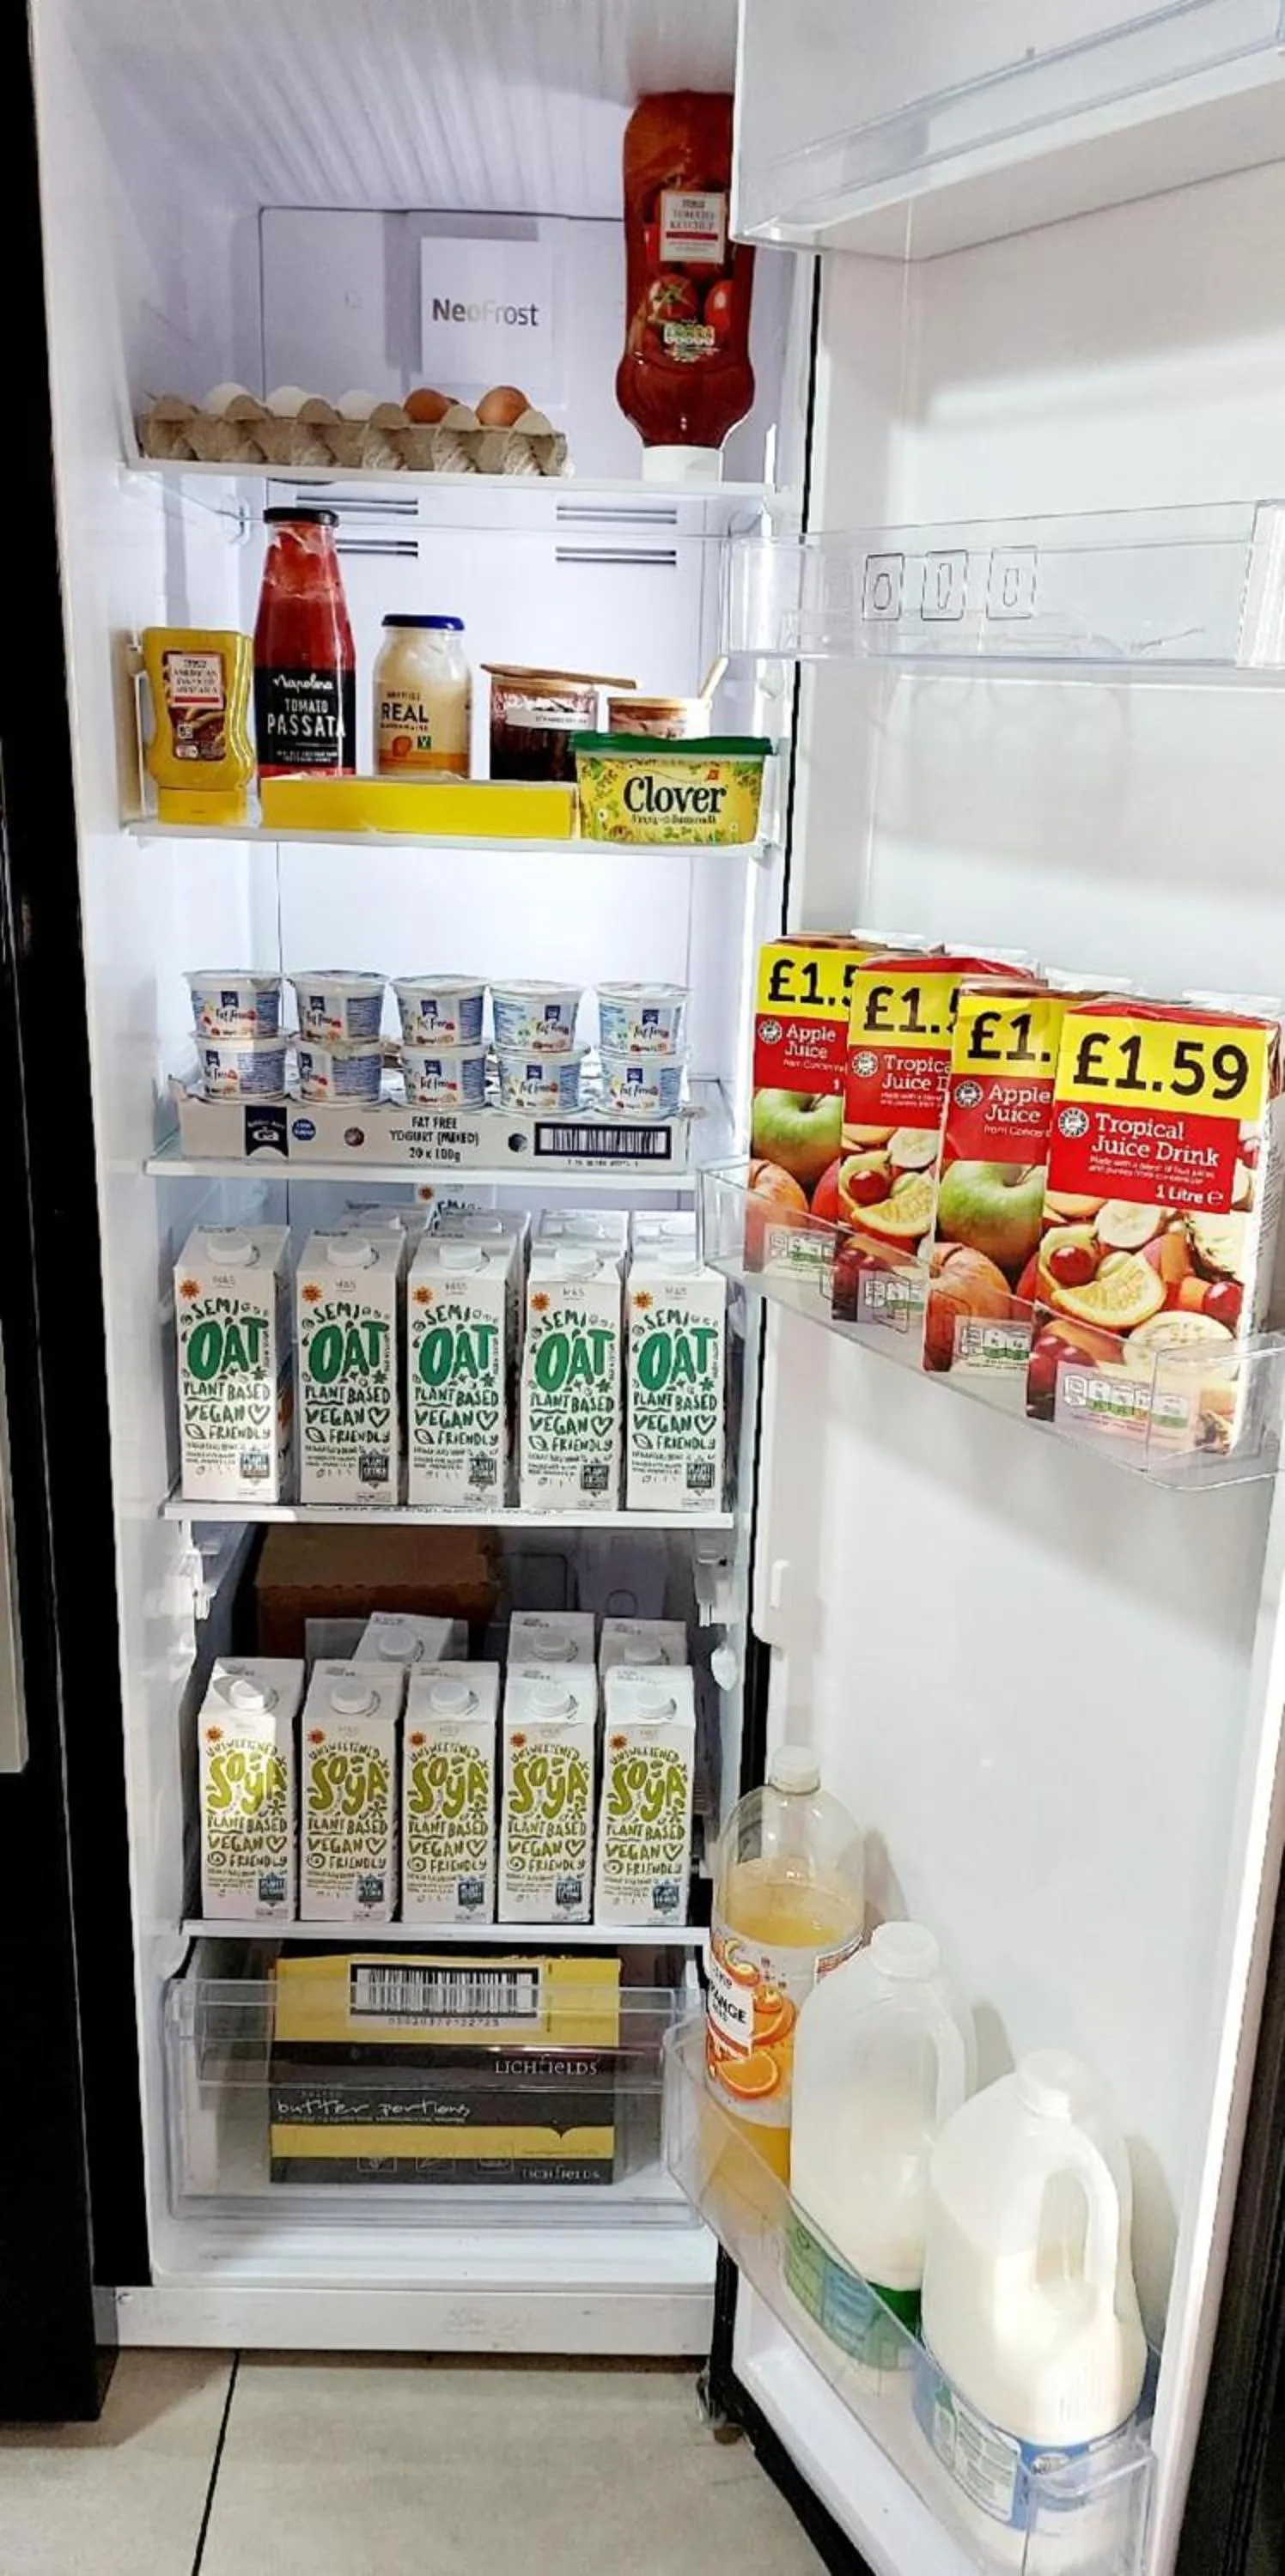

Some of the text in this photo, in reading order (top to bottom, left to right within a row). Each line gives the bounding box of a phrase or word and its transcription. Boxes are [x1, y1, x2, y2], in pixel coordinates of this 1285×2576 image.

[432, 298, 539, 326] NeoFrost
[284, 698, 329, 714] TOMATO
[381, 702, 429, 723] REAL
[267, 714, 346, 738] PASSATA
[624, 775, 728, 813] Clover
[785, 1024, 837, 1042] Apple
[967, 1011, 1051, 1062] £1.
[783, 1042, 828, 1059] Juice
[1073, 1032, 1249, 1100] £1.59
[881, 1072, 932, 1091] Juice
[989, 1084, 1051, 1107] Apple
[411, 1115, 458, 1129] FAT FREE
[984, 1104, 1042, 1123] Juice
[1094, 1112, 1184, 1140] Tropical
[389, 1130, 434, 1143] YOGURT
[409, 1147, 423, 1158] 20
[435, 1147, 461, 1163] 100g
[1091, 1134, 1220, 1168] Juice Drink
[1155, 1184, 1203, 1204] 1 Litre
[191, 1297, 240, 1320] SEMI
[313, 1302, 360, 1323] SEMI
[424, 1304, 471, 1325] SEMI
[541, 1309, 587, 1331] SEMI
[643, 1309, 689, 1330] SEMI
[187, 1316, 269, 1381] OAT
[308, 1320, 390, 1384] OAT
[418, 1323, 499, 1387] OAT
[535, 1328, 616, 1393] OAT
[637, 1327, 719, 1391] OAT
[183, 1382, 271, 1401] PLANT BASED
[305, 1385, 391, 1404] PLANT BASED
[415, 1388, 499, 1407] PLANT BASED
[530, 1394, 615, 1414] PLANT BASED
[633, 1392, 717, 1412] PLANT BASED
[184, 1404, 246, 1423] VEGAN
[305, 1407, 365, 1425] VEGAN
[415, 1409, 474, 1429] VEGAN
[209, 1425, 271, 1440] FRIENDLY
[529, 1417, 589, 1436] VEGAN
[633, 1414, 692, 1434] VEGAN
[330, 1429, 391, 1443] FRIENDLY
[438, 1431, 499, 1446] FRIENDLY
[552, 1438, 613, 1452] FRIENDLY
[657, 1437, 716, 1450] FRIENDLY
[207, 1815, 288, 1833] PLANT BASED
[308, 1818, 388, 1836] PLANT BASED
[409, 1820, 489, 1839] PLANT BASED
[508, 1820, 587, 1838] PLANT BASED
[606, 1824, 685, 1841] PLANT BASED
[208, 1836, 265, 1852] VEGAN
[307, 1838, 363, 1855] VEGAN
[408, 1840, 465, 1858] VEGAN
[508, 1840, 563, 1857] VEGAN
[605, 1844, 661, 1862] VEGAN
[229, 1855, 288, 1868] FRIENDLY
[329, 1857, 387, 1869] FRIENDLY
[430, 1860, 487, 1873] FRIENDLY
[529, 1859, 585, 1874] FRIENDLY
[626, 1862, 682, 1876] FRIENDLY
